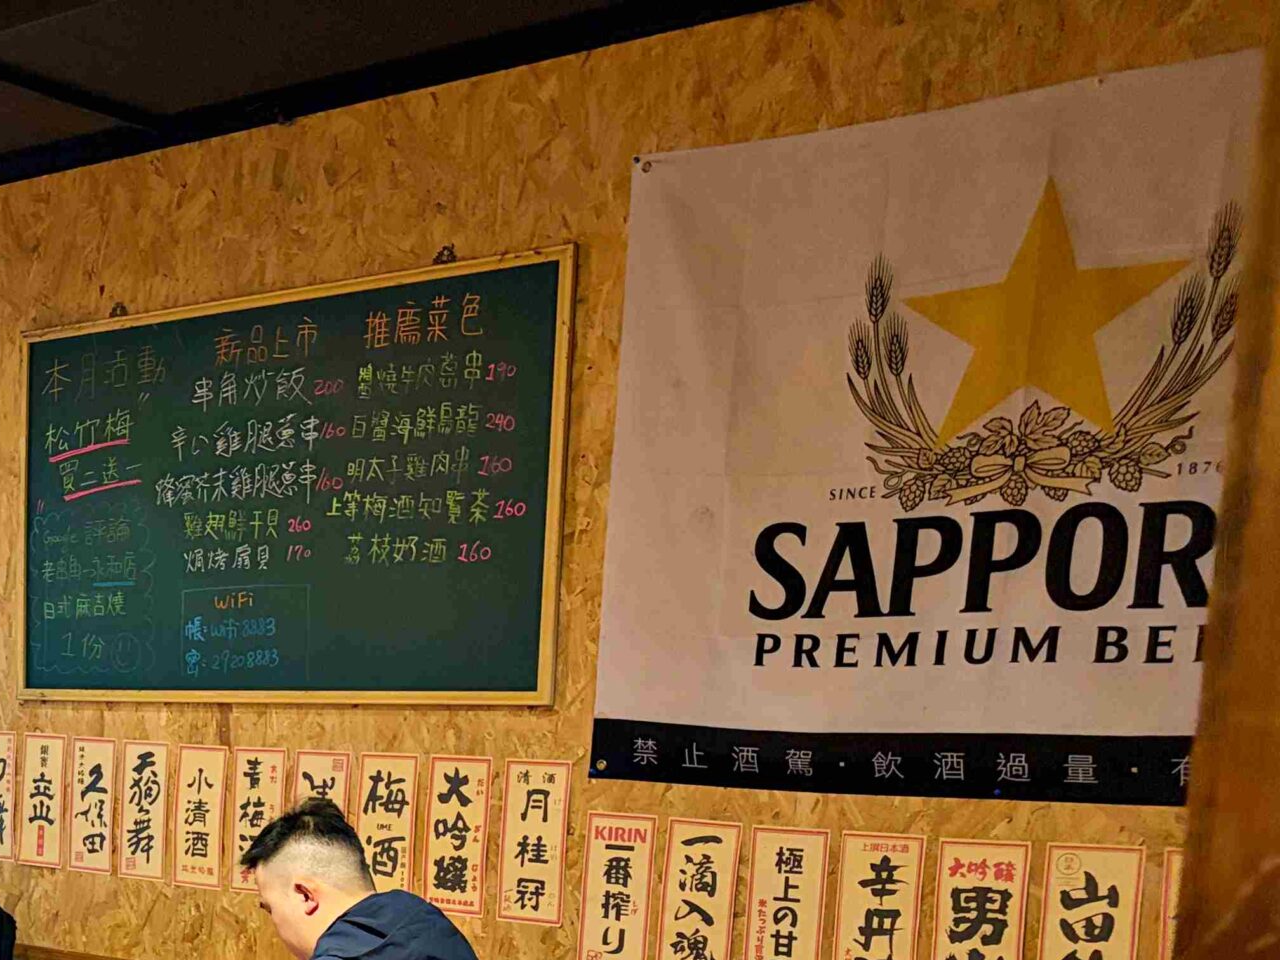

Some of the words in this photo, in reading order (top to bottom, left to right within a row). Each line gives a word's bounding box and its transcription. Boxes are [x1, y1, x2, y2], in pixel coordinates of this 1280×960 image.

[214, 315, 318, 366] 新品上市
[485, 361, 518, 383] 190
[44, 407, 134, 452] 松竹梅
[320, 422, 346, 440] 160
[485, 412, 516, 433] 240
[58, 456, 143, 493] 買二送一
[477, 455, 513, 477] 160
[316, 467, 345, 491] 160
[829, 484, 877, 502] SINCE
[492, 499, 527, 520] 160
[287, 515, 312, 533] 260
[286, 545, 312, 562] 170
[456, 540, 492, 563] 160
[753, 625, 1063, 668] PREMIUM
[516, 770, 557, 786] 清酒
[28, 771, 56, 826] 立山
[74, 762, 109, 854] 久保田
[184, 767, 215, 859] 小清酒
[363, 769, 410, 878] 梅酒
[376, 823, 393, 832] UME
[593, 825, 648, 844] KIRIN
[514, 788, 551, 912] 月桂冠
[600, 843, 635, 955] 一番搾り
